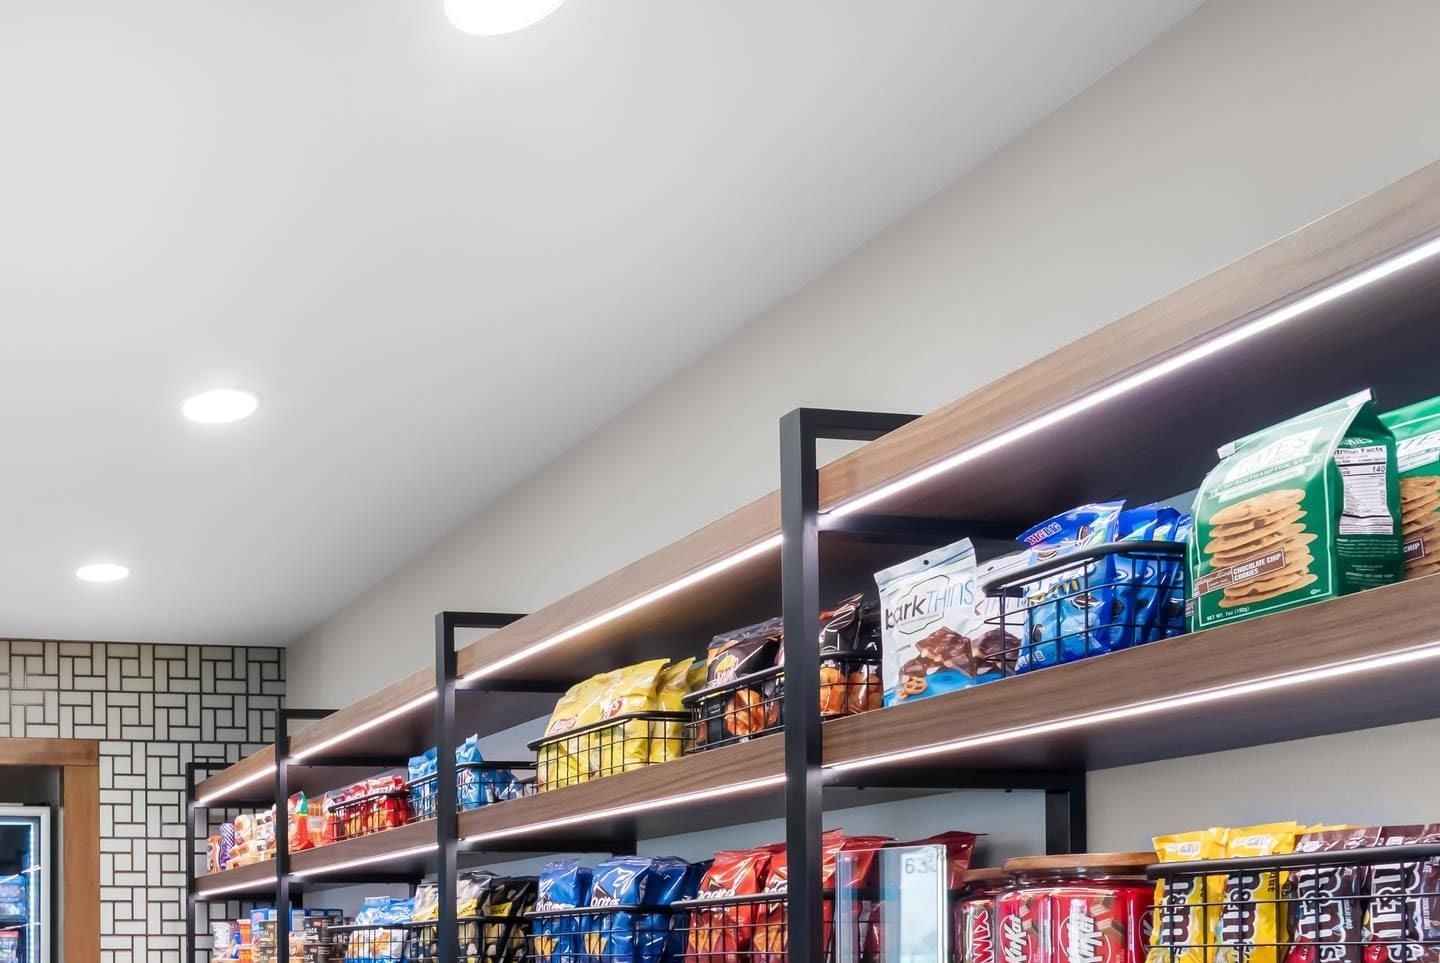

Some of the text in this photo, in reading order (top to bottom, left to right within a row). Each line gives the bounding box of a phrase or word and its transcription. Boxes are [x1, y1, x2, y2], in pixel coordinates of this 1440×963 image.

[1233, 553, 1282, 576] CHOCOLATE CHIP
[1234, 567, 1259, 582] COOKIES
